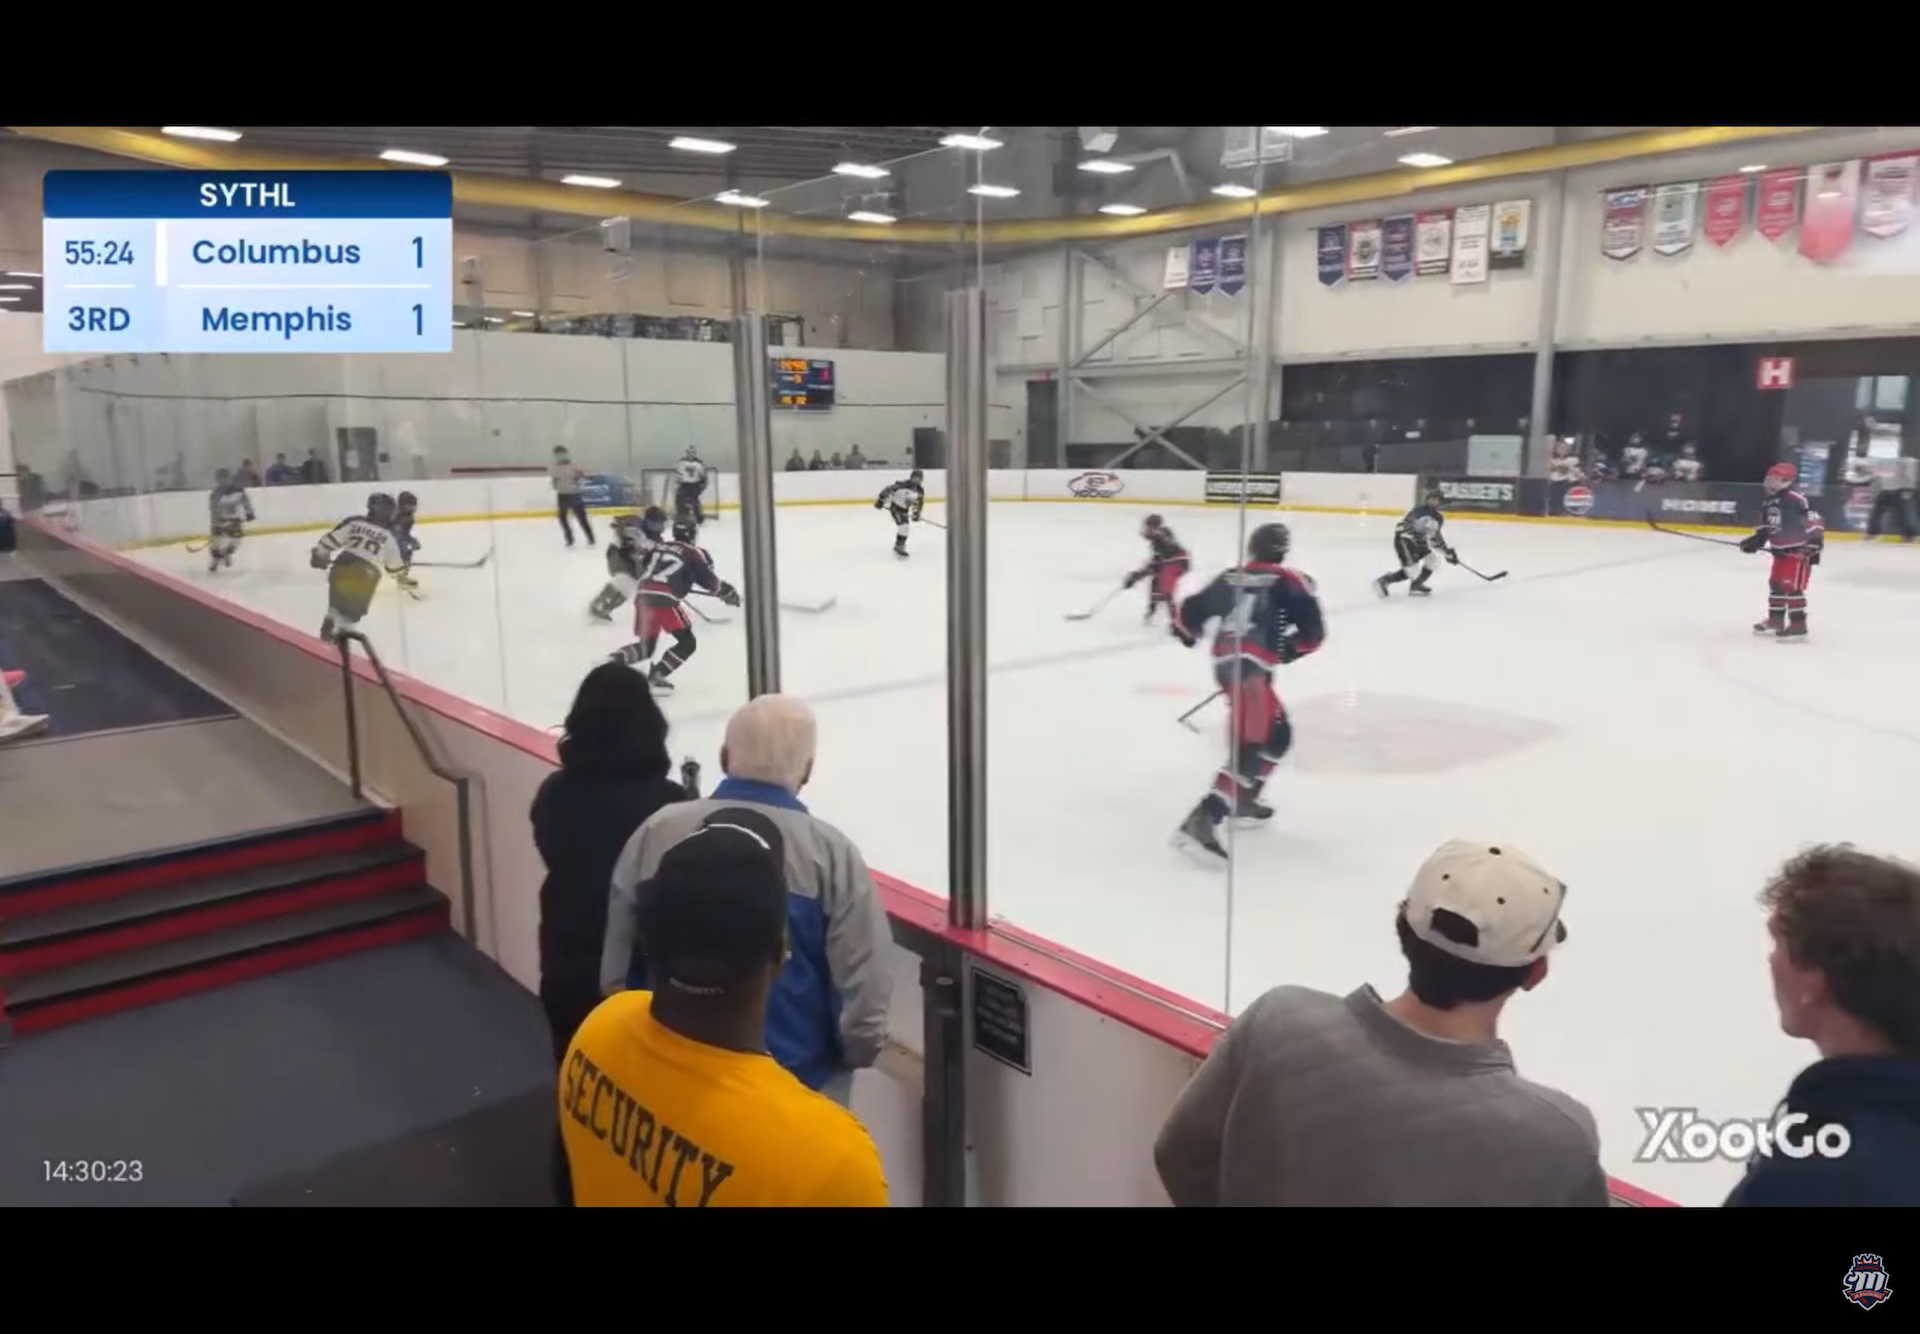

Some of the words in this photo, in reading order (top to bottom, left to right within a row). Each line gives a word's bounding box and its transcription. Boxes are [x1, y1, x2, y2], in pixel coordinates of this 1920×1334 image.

[1761, 361, 1790, 385] H
[1661, 498, 1738, 514] HOME
[562, 1049, 734, 1206] SECURITY
